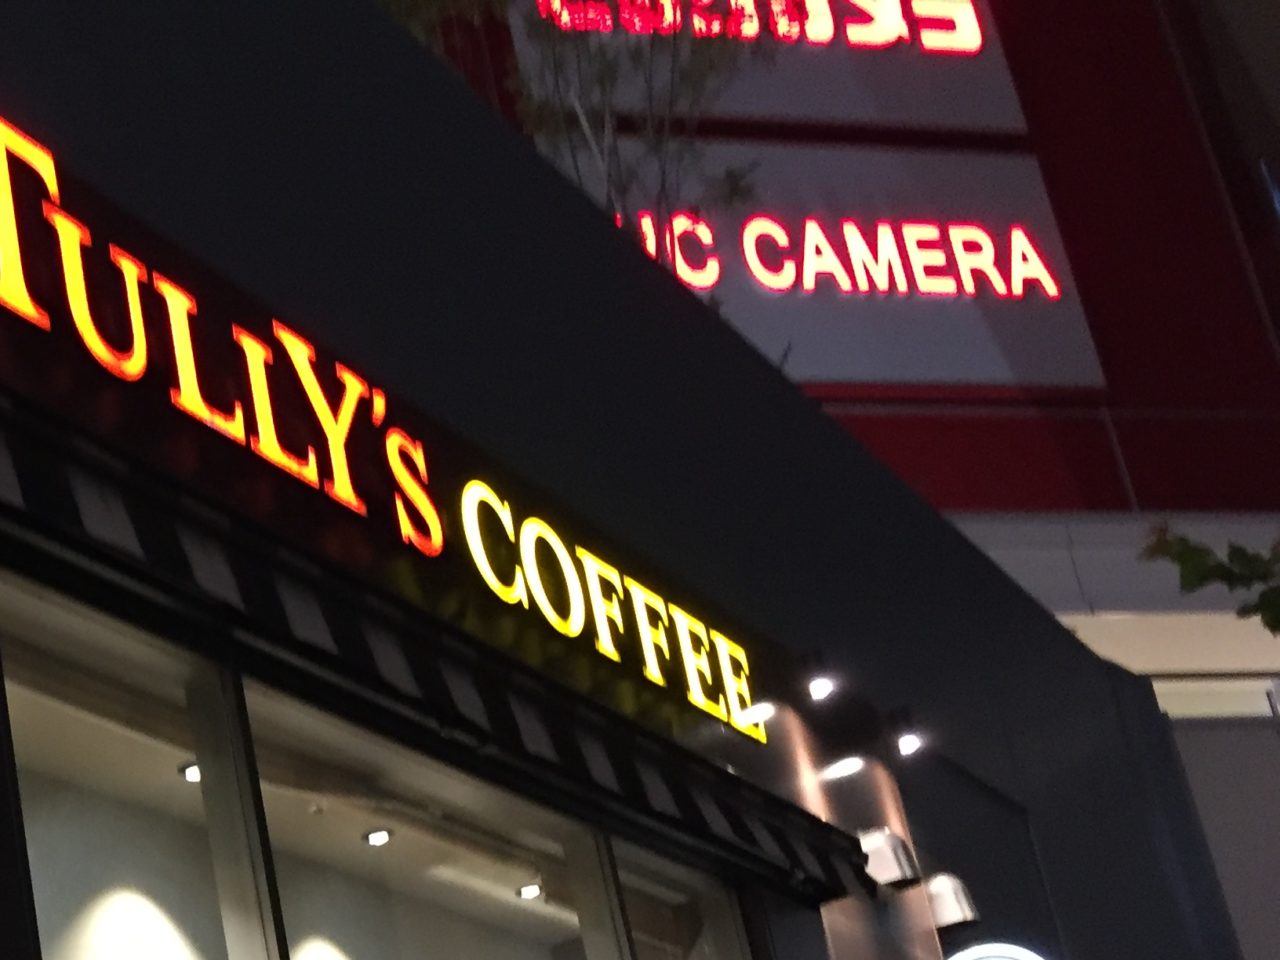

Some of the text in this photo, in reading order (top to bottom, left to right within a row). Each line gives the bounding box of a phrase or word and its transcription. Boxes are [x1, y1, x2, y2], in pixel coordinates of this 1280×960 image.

[614, 209, 1061, 300] IC CAMERA
[460, 478, 767, 744] COFFEE
